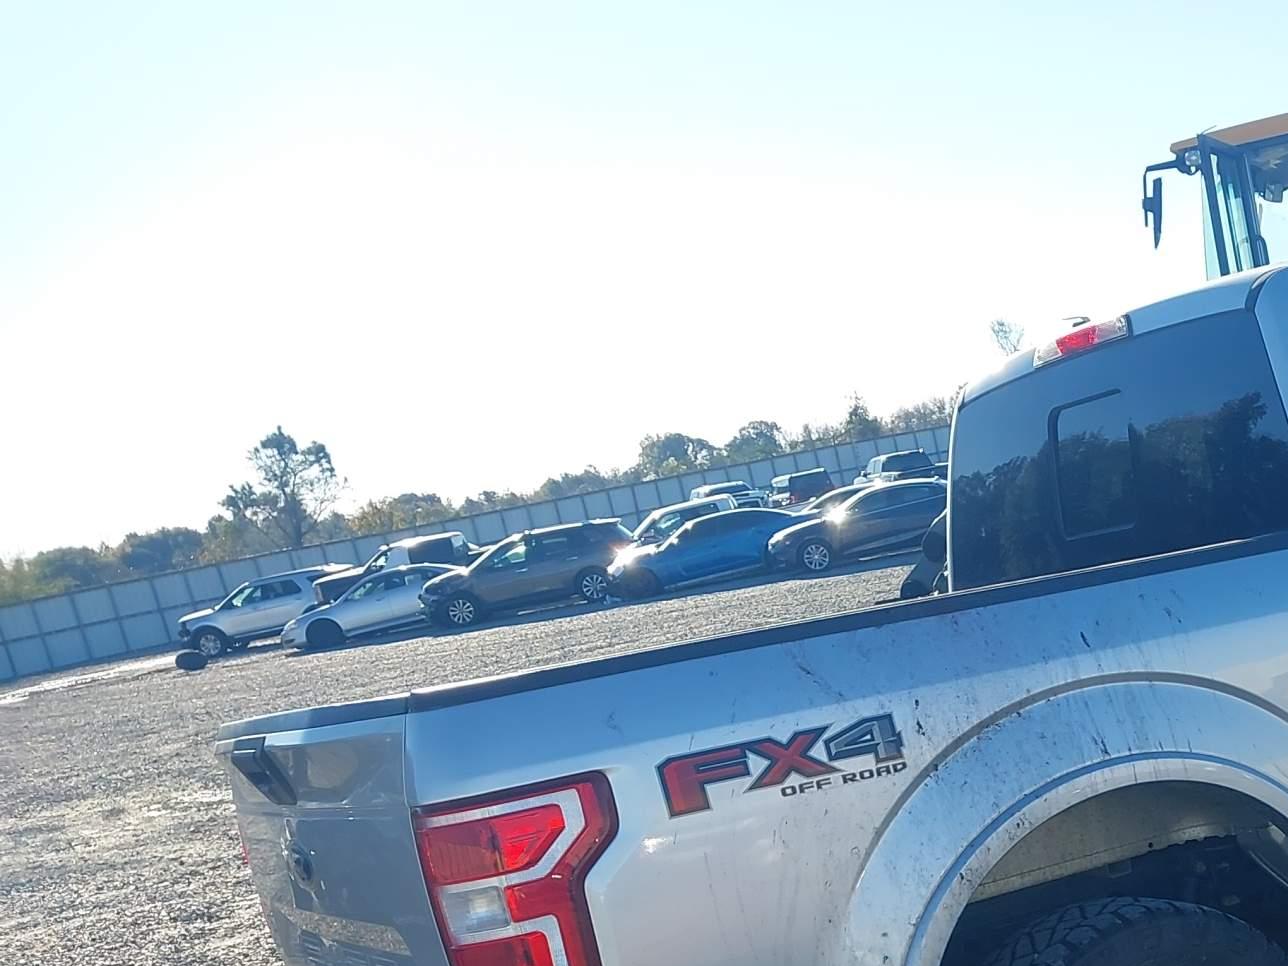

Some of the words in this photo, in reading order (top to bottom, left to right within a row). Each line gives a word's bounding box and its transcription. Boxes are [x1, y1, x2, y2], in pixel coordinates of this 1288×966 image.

[655, 711, 904, 819] FX4
[780, 777, 832, 797] OFF
[841, 761, 907, 784] ROAD
